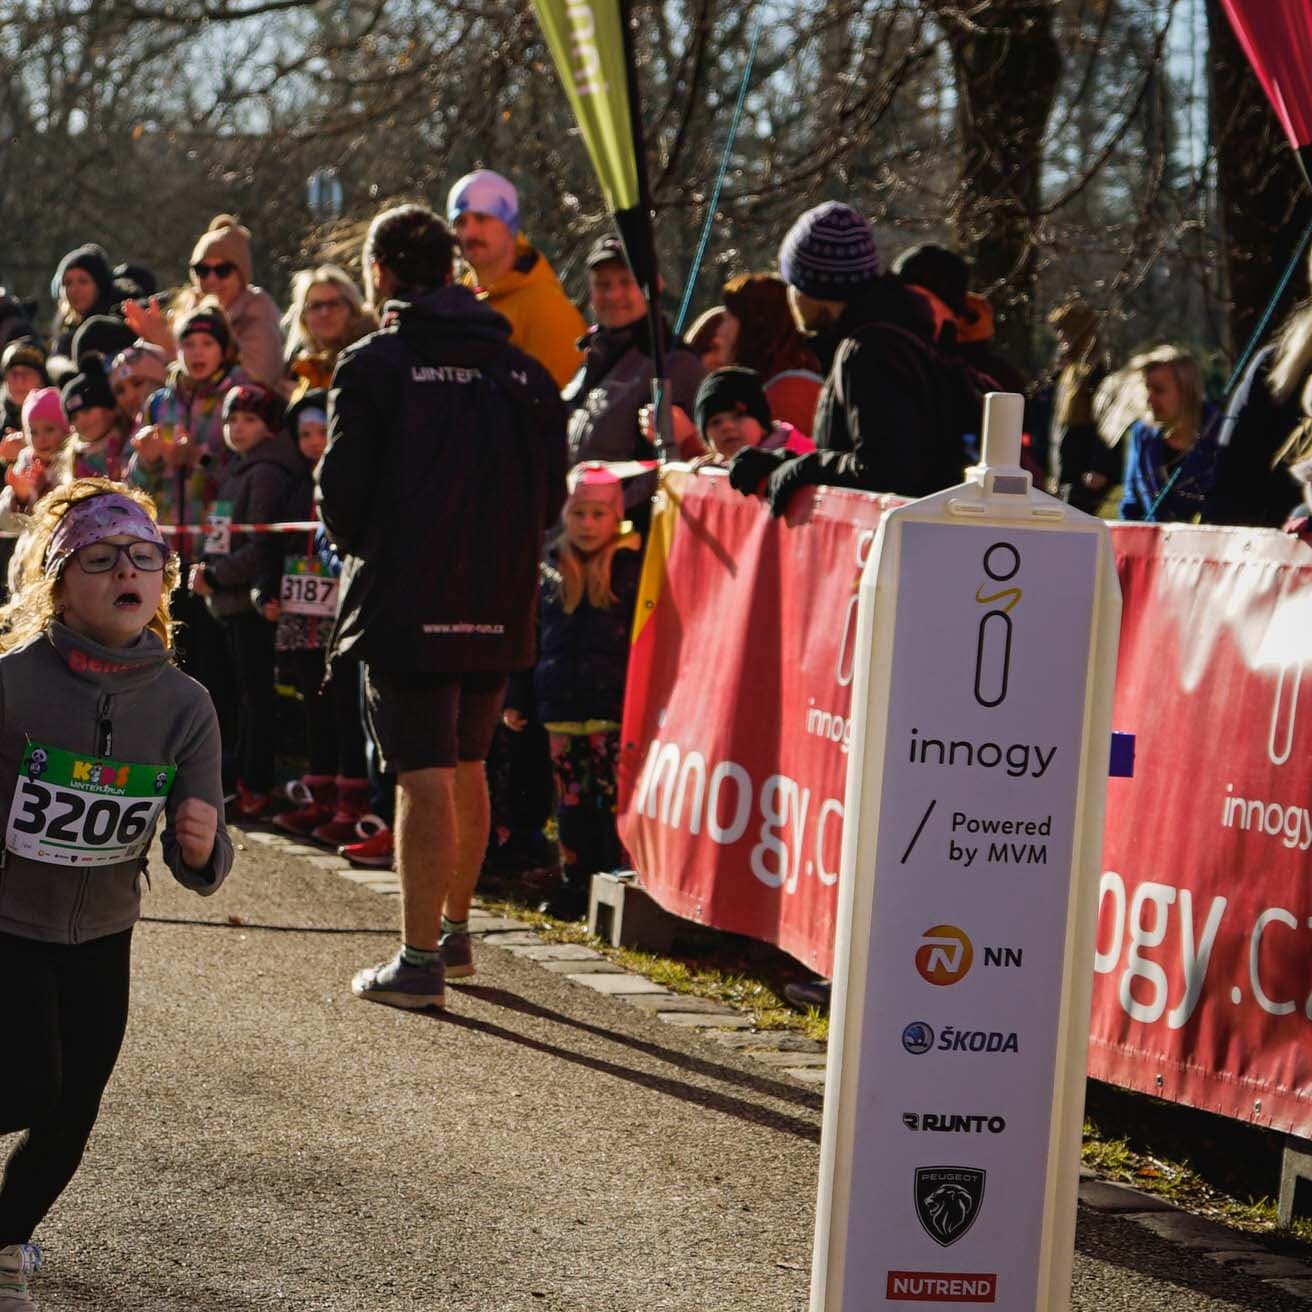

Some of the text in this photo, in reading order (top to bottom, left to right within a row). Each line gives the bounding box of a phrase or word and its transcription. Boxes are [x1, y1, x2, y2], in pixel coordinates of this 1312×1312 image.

[807, 697, 852, 754] innog
[909, 728, 1058, 778] innogy
[13, 782, 153, 846] 3206
[637, 708, 845, 896] innogy.c
[952, 812, 1052, 837] Powered
[949, 840, 1048, 868] by MVM
[983, 946, 1023, 968] NN
[937, 1026, 1019, 1054] ŠKODA
[922, 1112, 1006, 1134] RUNTO
[921, 1173, 979, 1182] PEUGEOT
[893, 1277, 991, 1297] NUTREND
